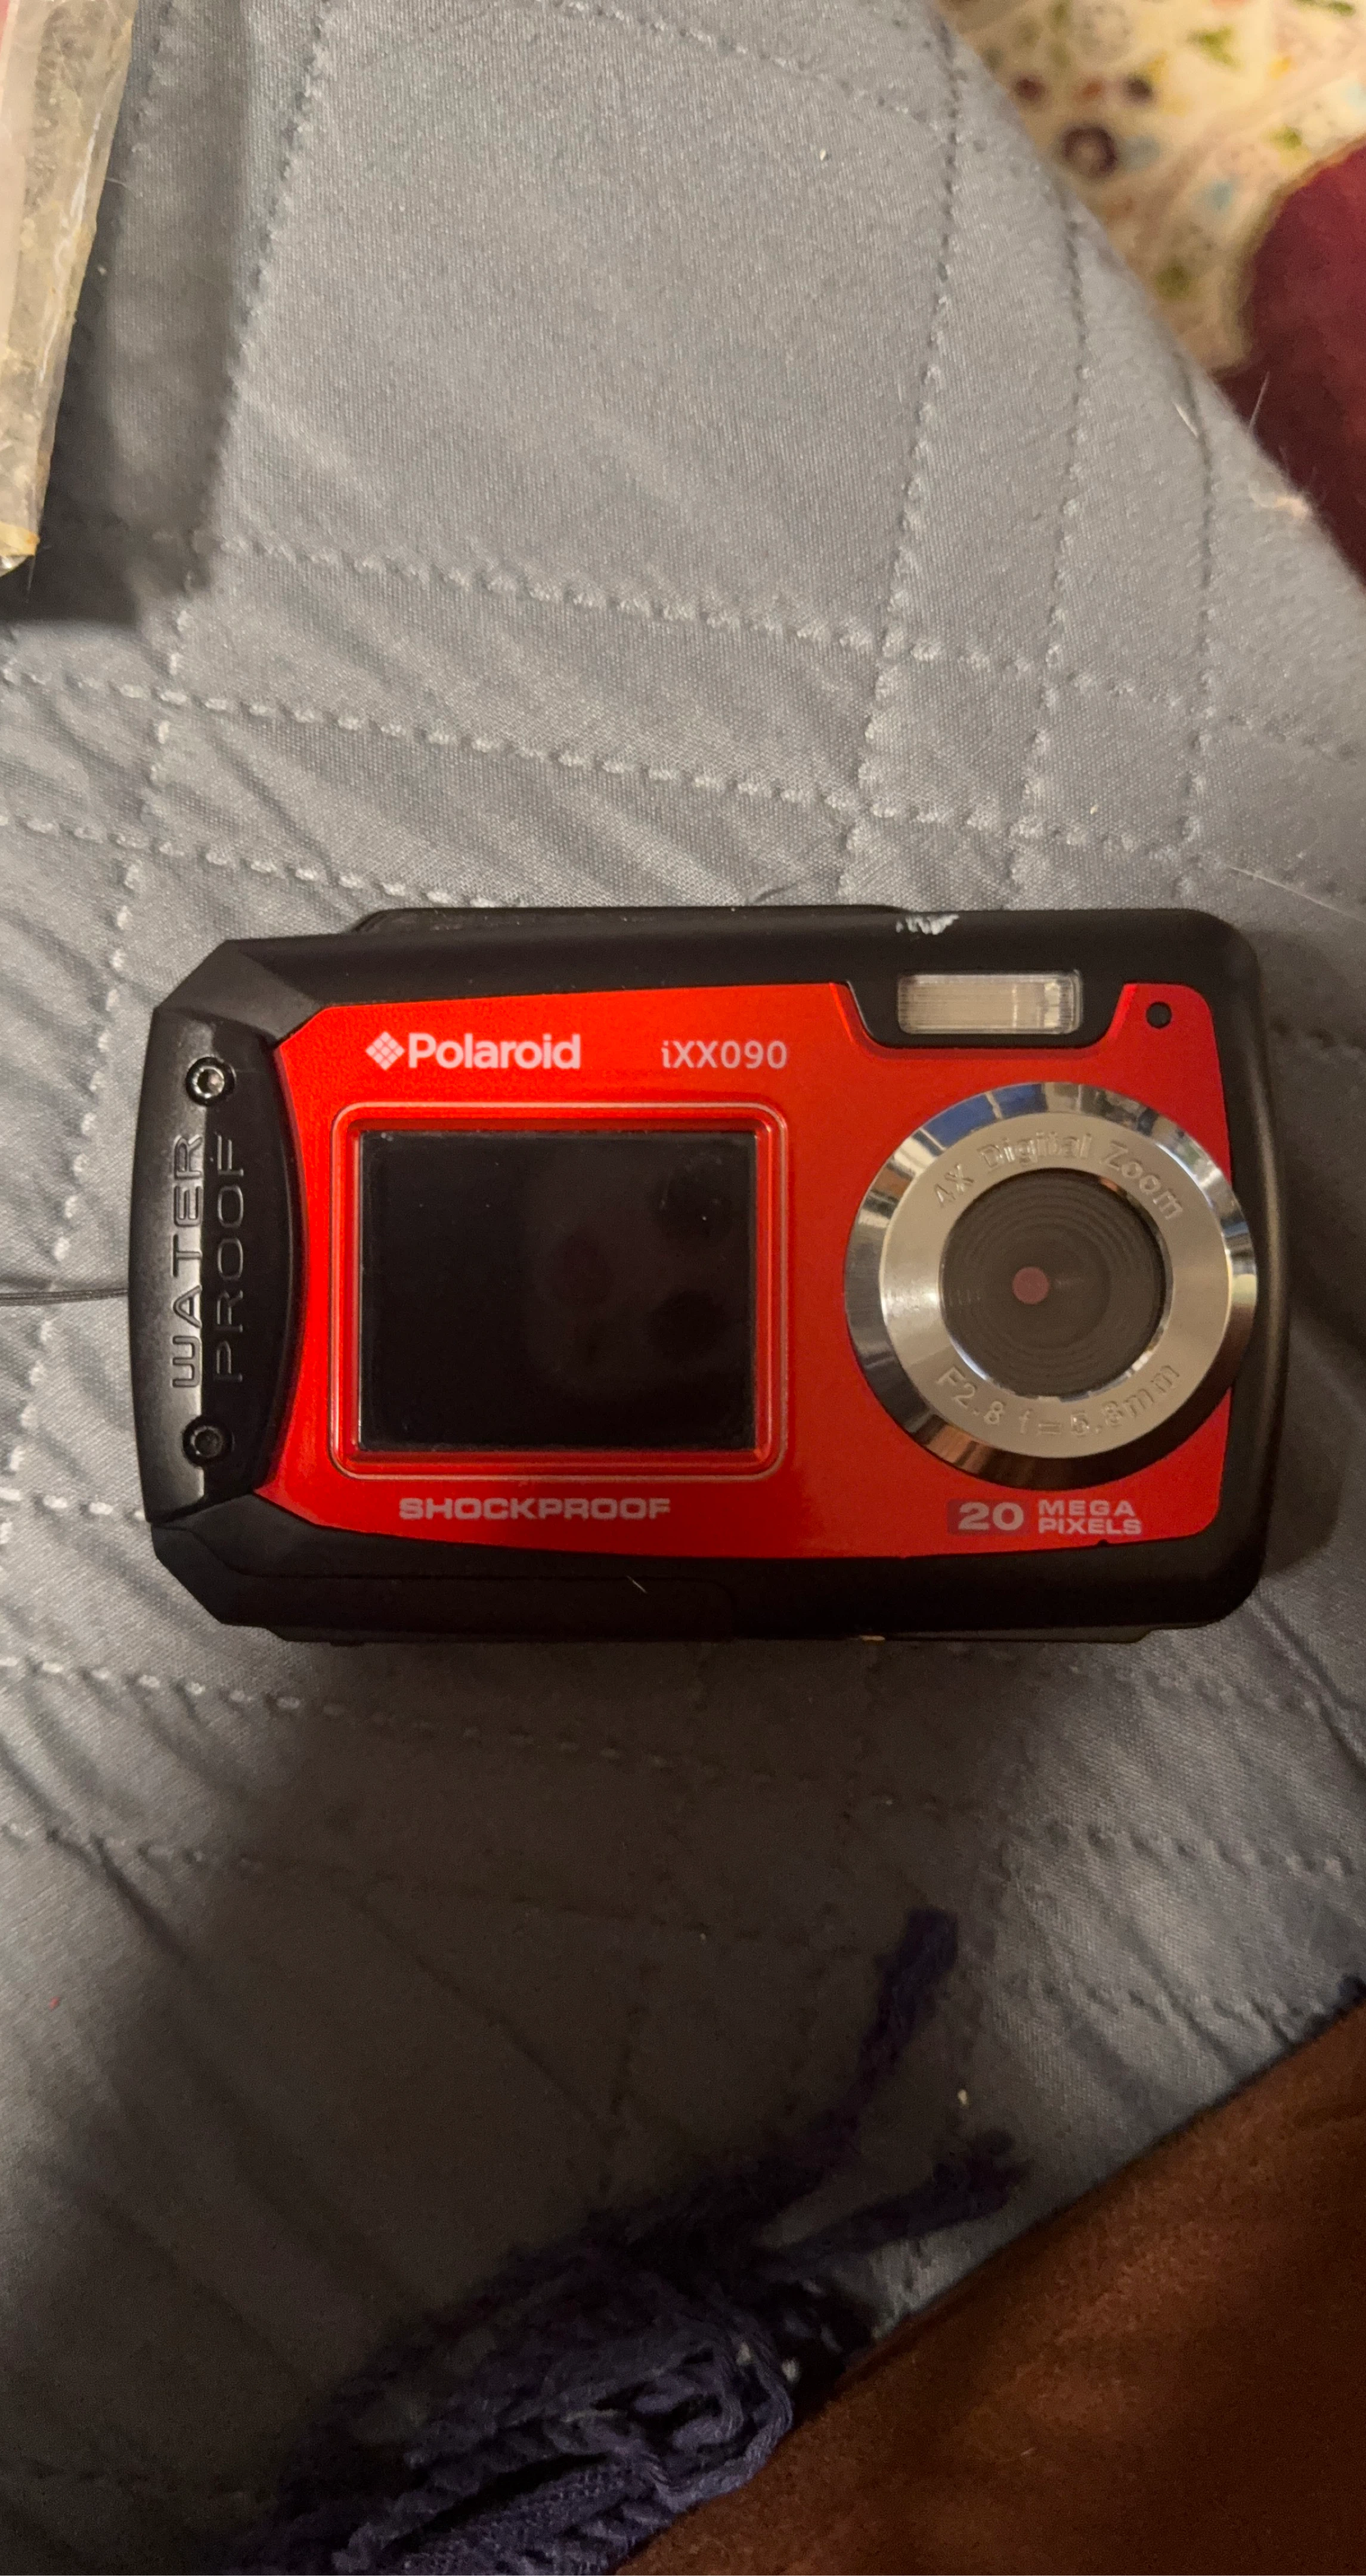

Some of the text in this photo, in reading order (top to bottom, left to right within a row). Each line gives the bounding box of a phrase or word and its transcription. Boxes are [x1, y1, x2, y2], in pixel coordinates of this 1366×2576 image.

[408, 1033, 581, 1069] Polaroid
[661, 1039, 788, 1070] iXX090
[977, 1131, 1092, 1174] Digital
[1100, 1140, 1184, 1220] Zoom
[172, 1134, 203, 1388] WATER
[214, 1133, 244, 1382] PROOF
[936, 1364, 1006, 1426] F2.8
[399, 1497, 671, 1520] SHOCKPROOF
[958, 1501, 1025, 1531] 20
[1038, 1499, 1136, 1517] MEGA
[1038, 1518, 1142, 1535] PIXELS
